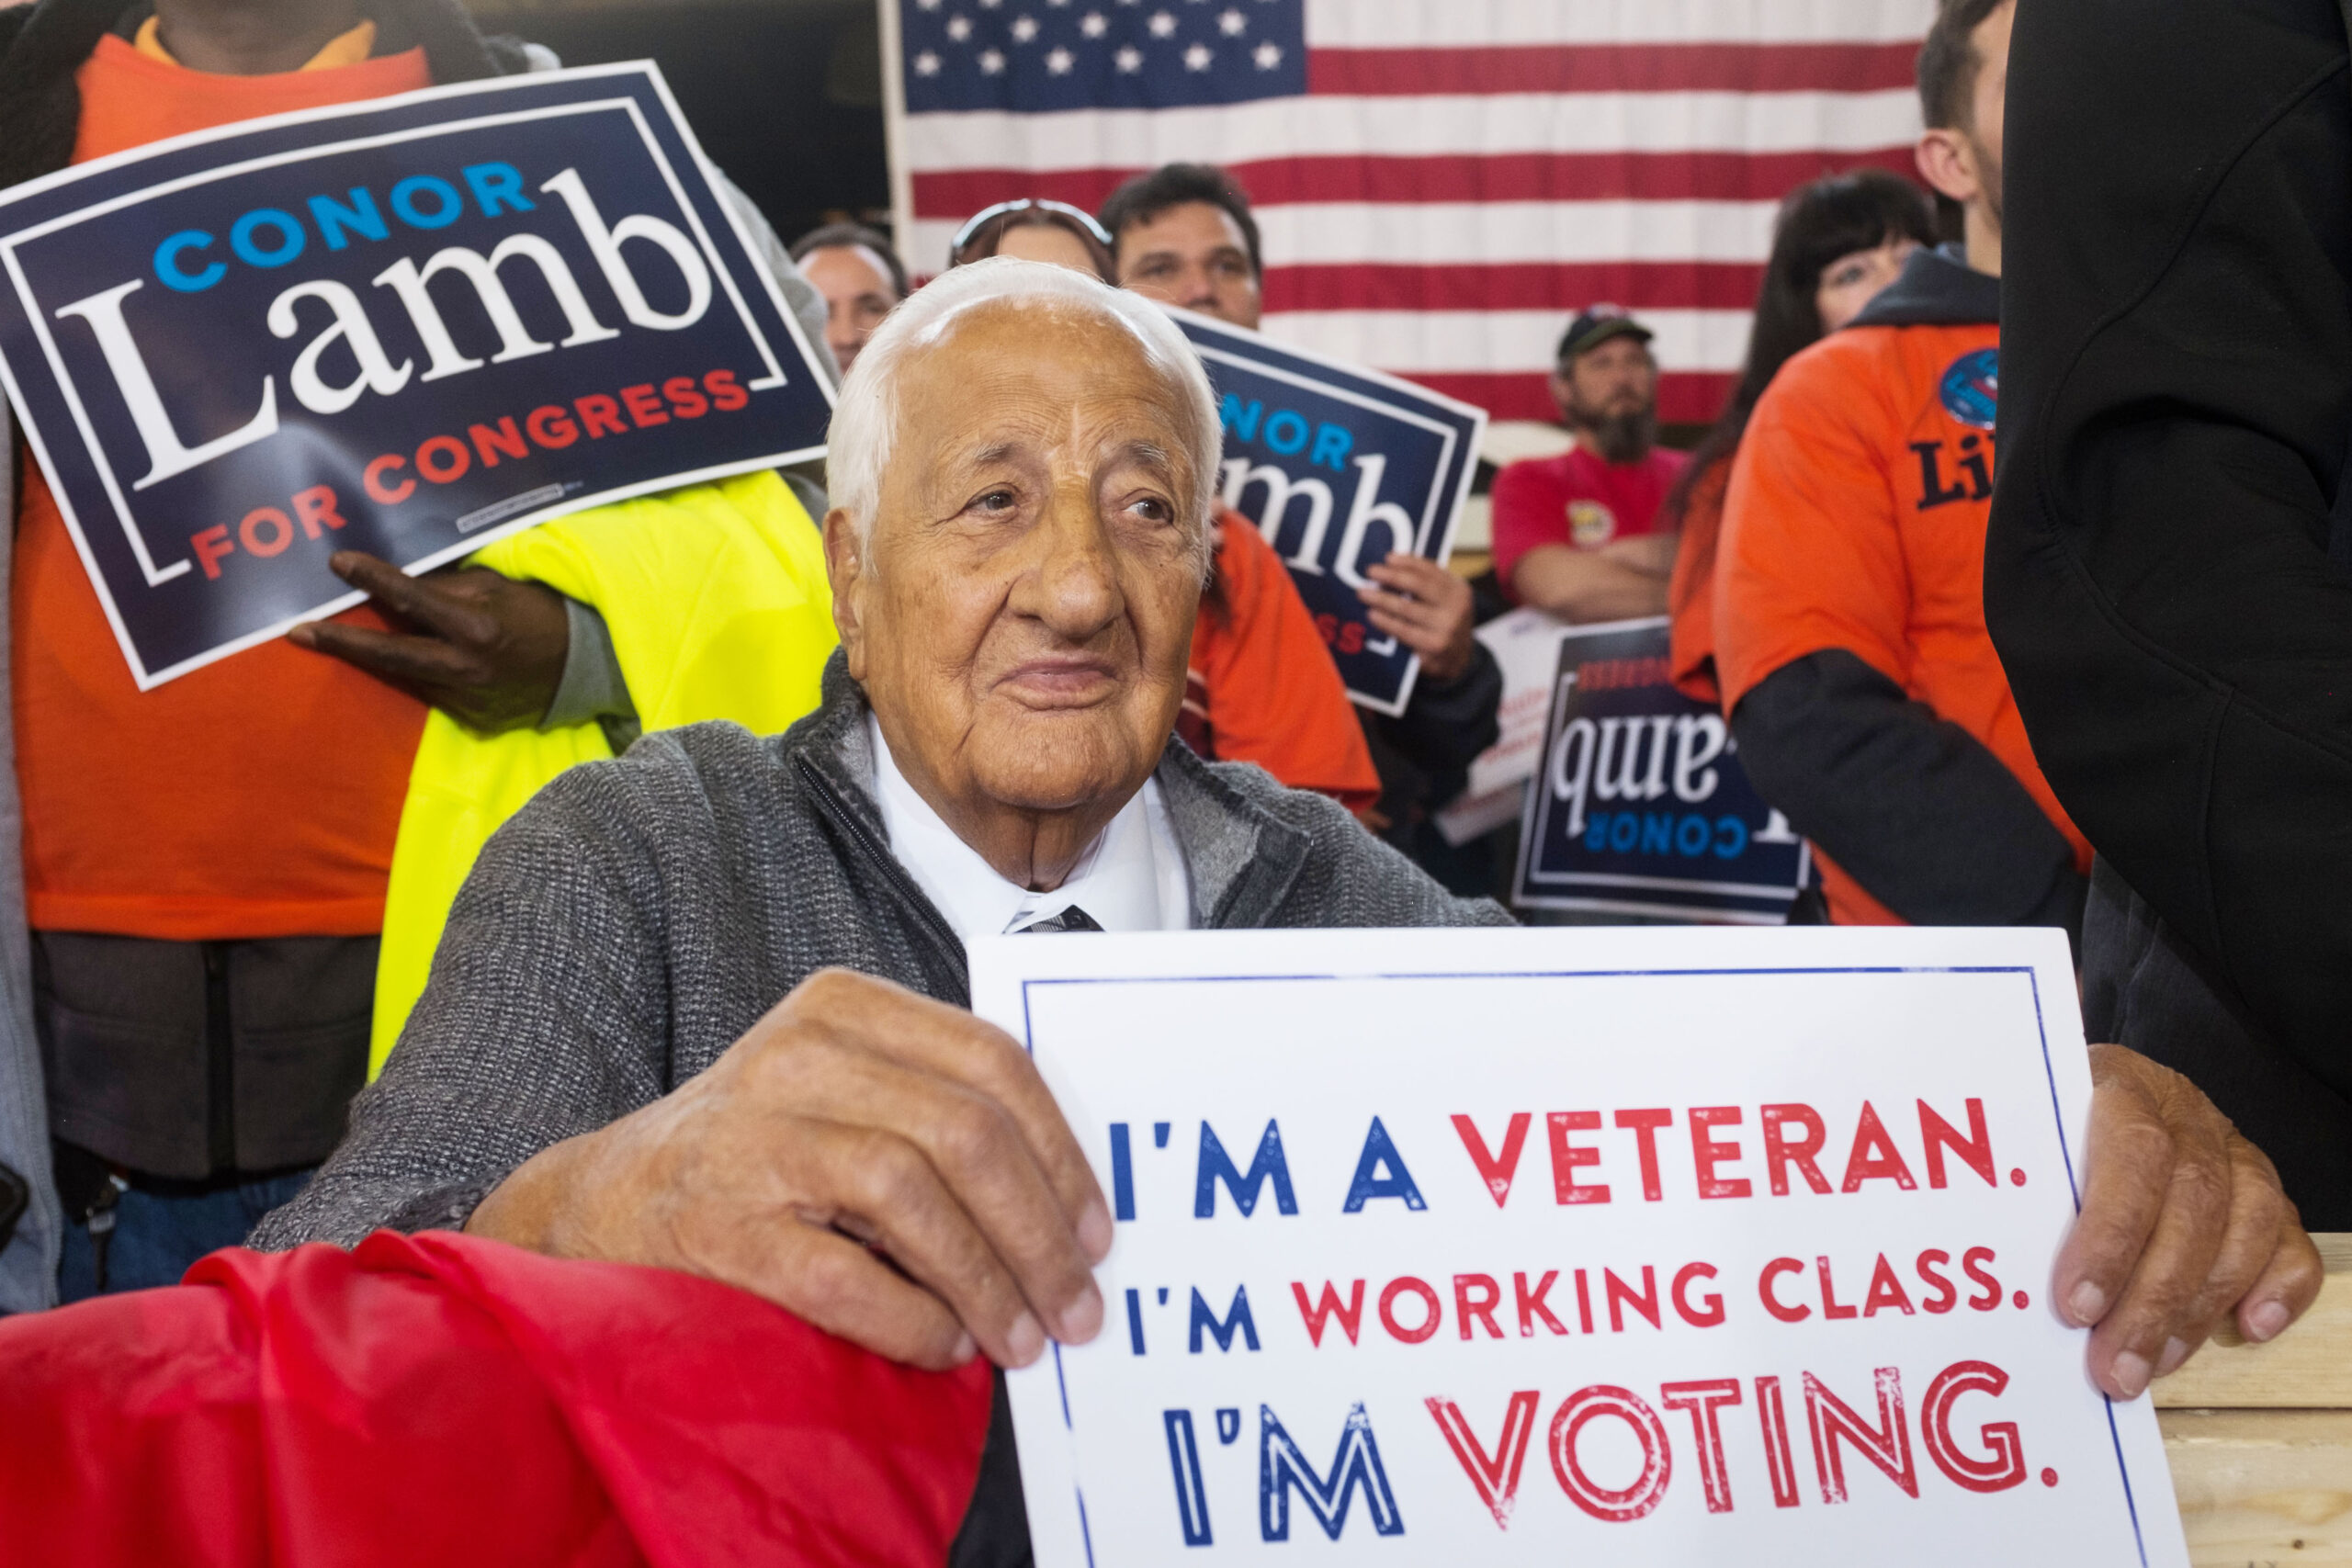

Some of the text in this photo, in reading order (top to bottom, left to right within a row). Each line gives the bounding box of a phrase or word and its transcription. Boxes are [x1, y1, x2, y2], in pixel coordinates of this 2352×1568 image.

[153, 161, 537, 293] CONOR
[54, 167, 713, 491] Lamb
[190, 485, 346, 580] FOR
[363, 369, 749, 504] CONGRESS
[1219, 393, 1353, 472] NOR
[1219, 453, 1415, 592] mb
[1584, 811, 1747, 861] CONOR
[1109, 1096, 2028, 1223] I'M A VETERAN.
[1123, 1246, 2030, 1357] I'M WORKING CLASS.
[1161, 1359, 2060, 1549] I'M VOTING.
